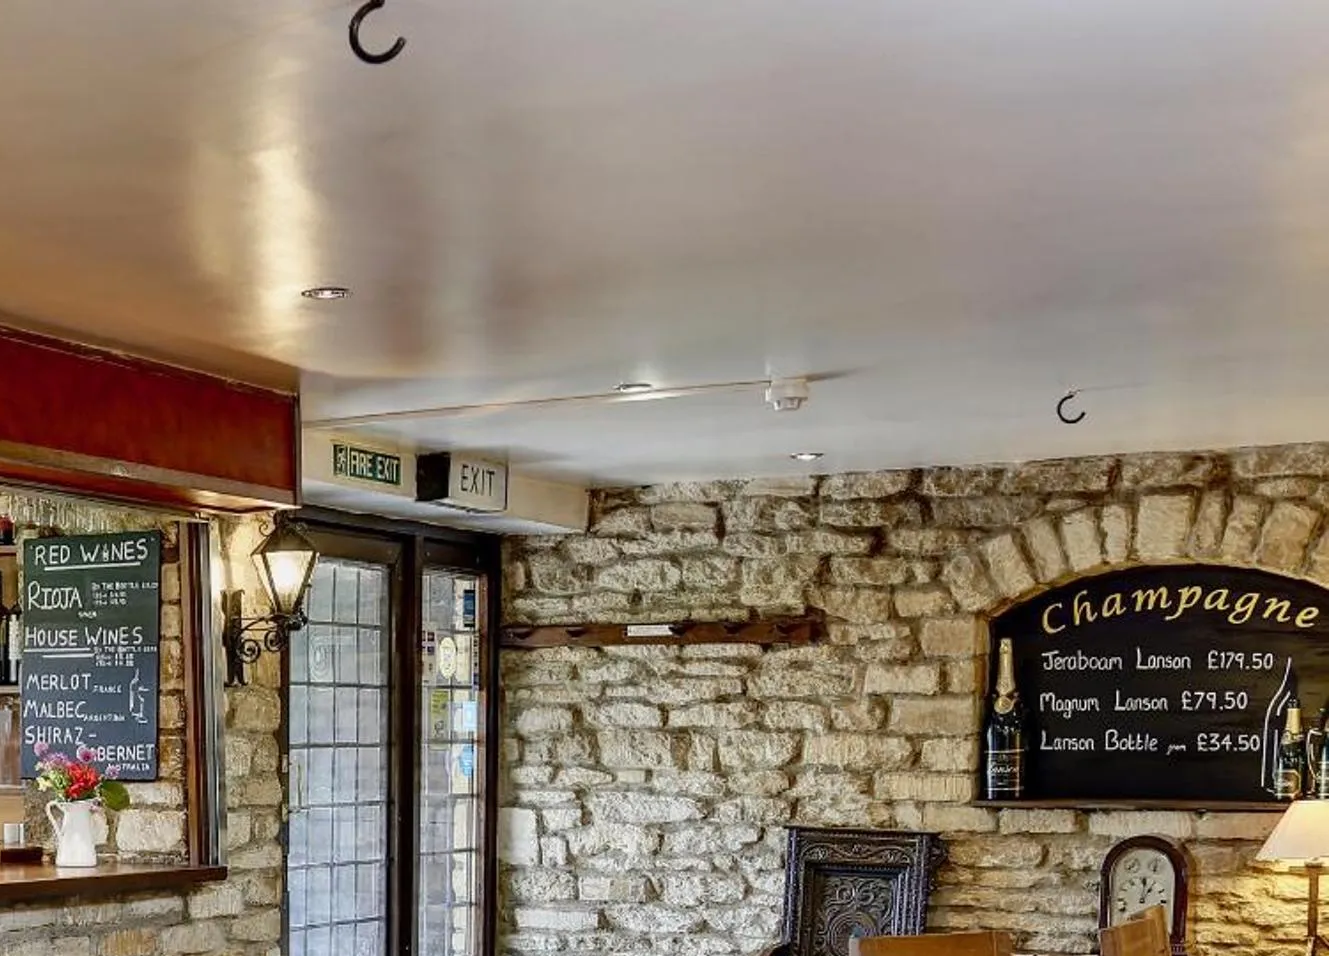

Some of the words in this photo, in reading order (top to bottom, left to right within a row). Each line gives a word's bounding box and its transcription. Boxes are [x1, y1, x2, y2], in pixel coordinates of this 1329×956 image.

[351, 451, 373, 477] FIRE
[377, 456, 399, 483] EXIT
[460, 464, 496, 497] EXIT
[34, 545, 71, 566] RED
[80, 538, 149, 562] WINES
[27, 581, 83, 611] RIOJA
[1042, 585, 1320, 634] Champagne
[24, 626, 78, 647] HOUSE
[85, 626, 144, 646] WINES
[1041, 649, 1123, 670] Jeroboam
[1136, 646, 1192, 669] Lanson
[1208, 650, 1274, 670] £179.50
[26, 673, 92, 690] MERLOT
[23, 699, 87, 719] MALBEC
[1039, 692, 1100, 719] Magnum
[1114, 689, 1169, 712] Lanson
[1181, 690, 1249, 711] £79.50
[25, 726, 84, 745] SHIRAZ
[1040, 729, 1095, 751] Lanson
[1105, 729, 1159, 752] Bottle
[1197, 733, 1261, 752] £34.50
